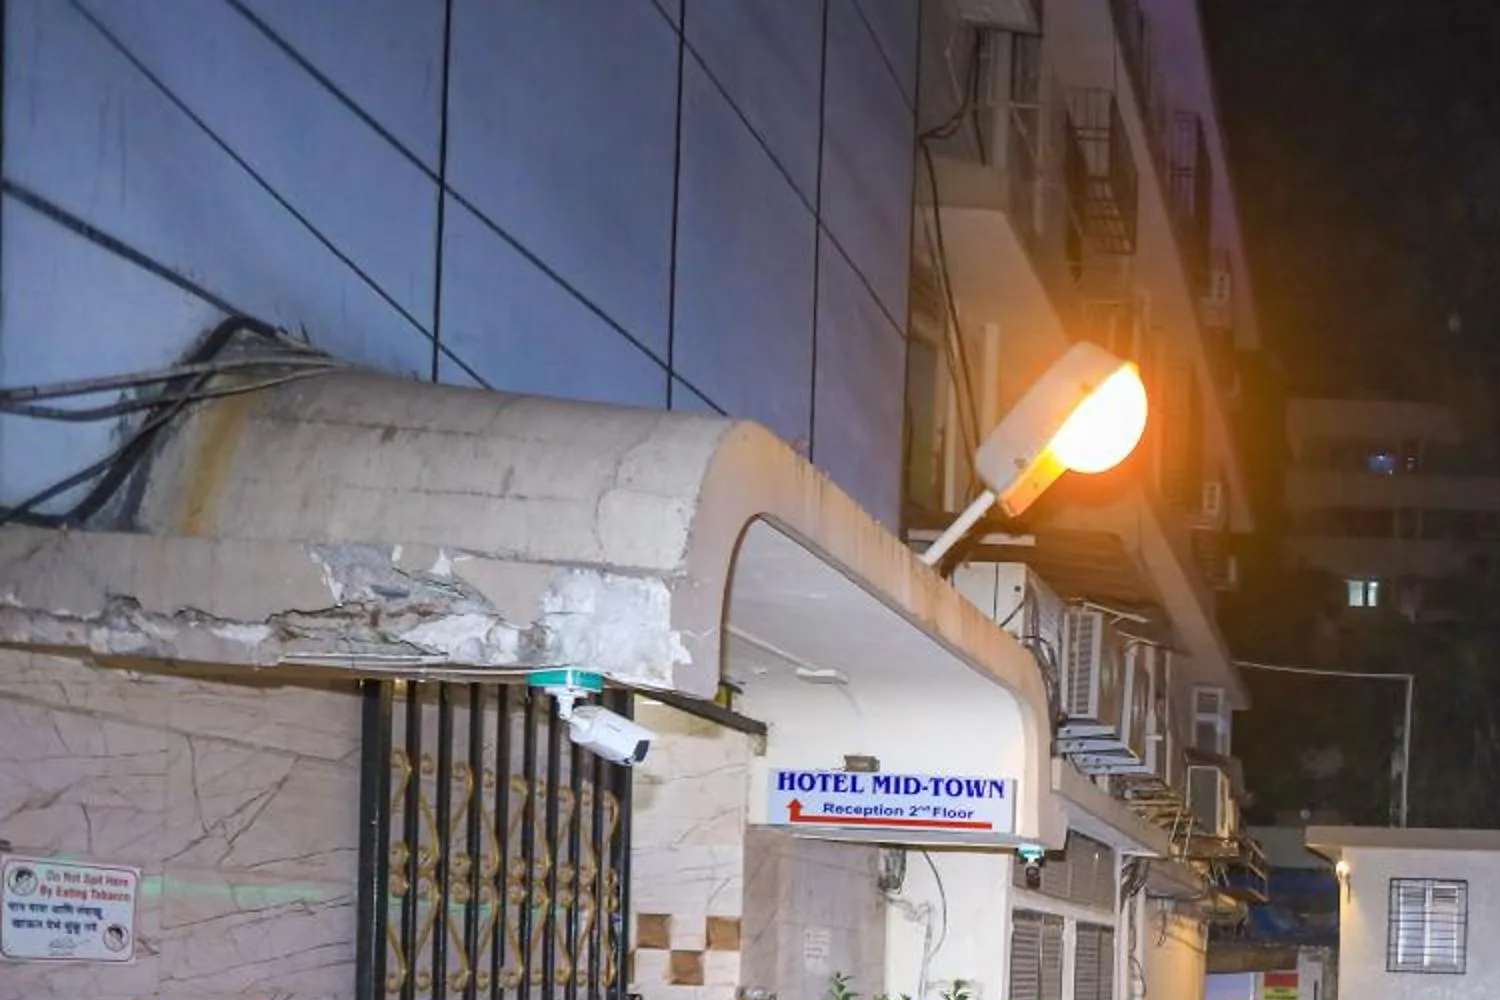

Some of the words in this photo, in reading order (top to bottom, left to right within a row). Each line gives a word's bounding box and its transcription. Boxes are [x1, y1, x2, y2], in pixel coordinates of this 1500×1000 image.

[777, 771, 865, 794] HOTEL
[872, 775, 1005, 799] MID-TOWN
[823, 802, 904, 818] Reception
[932, 806, 974, 820] Floor
[63, 872, 81, 885] Not
